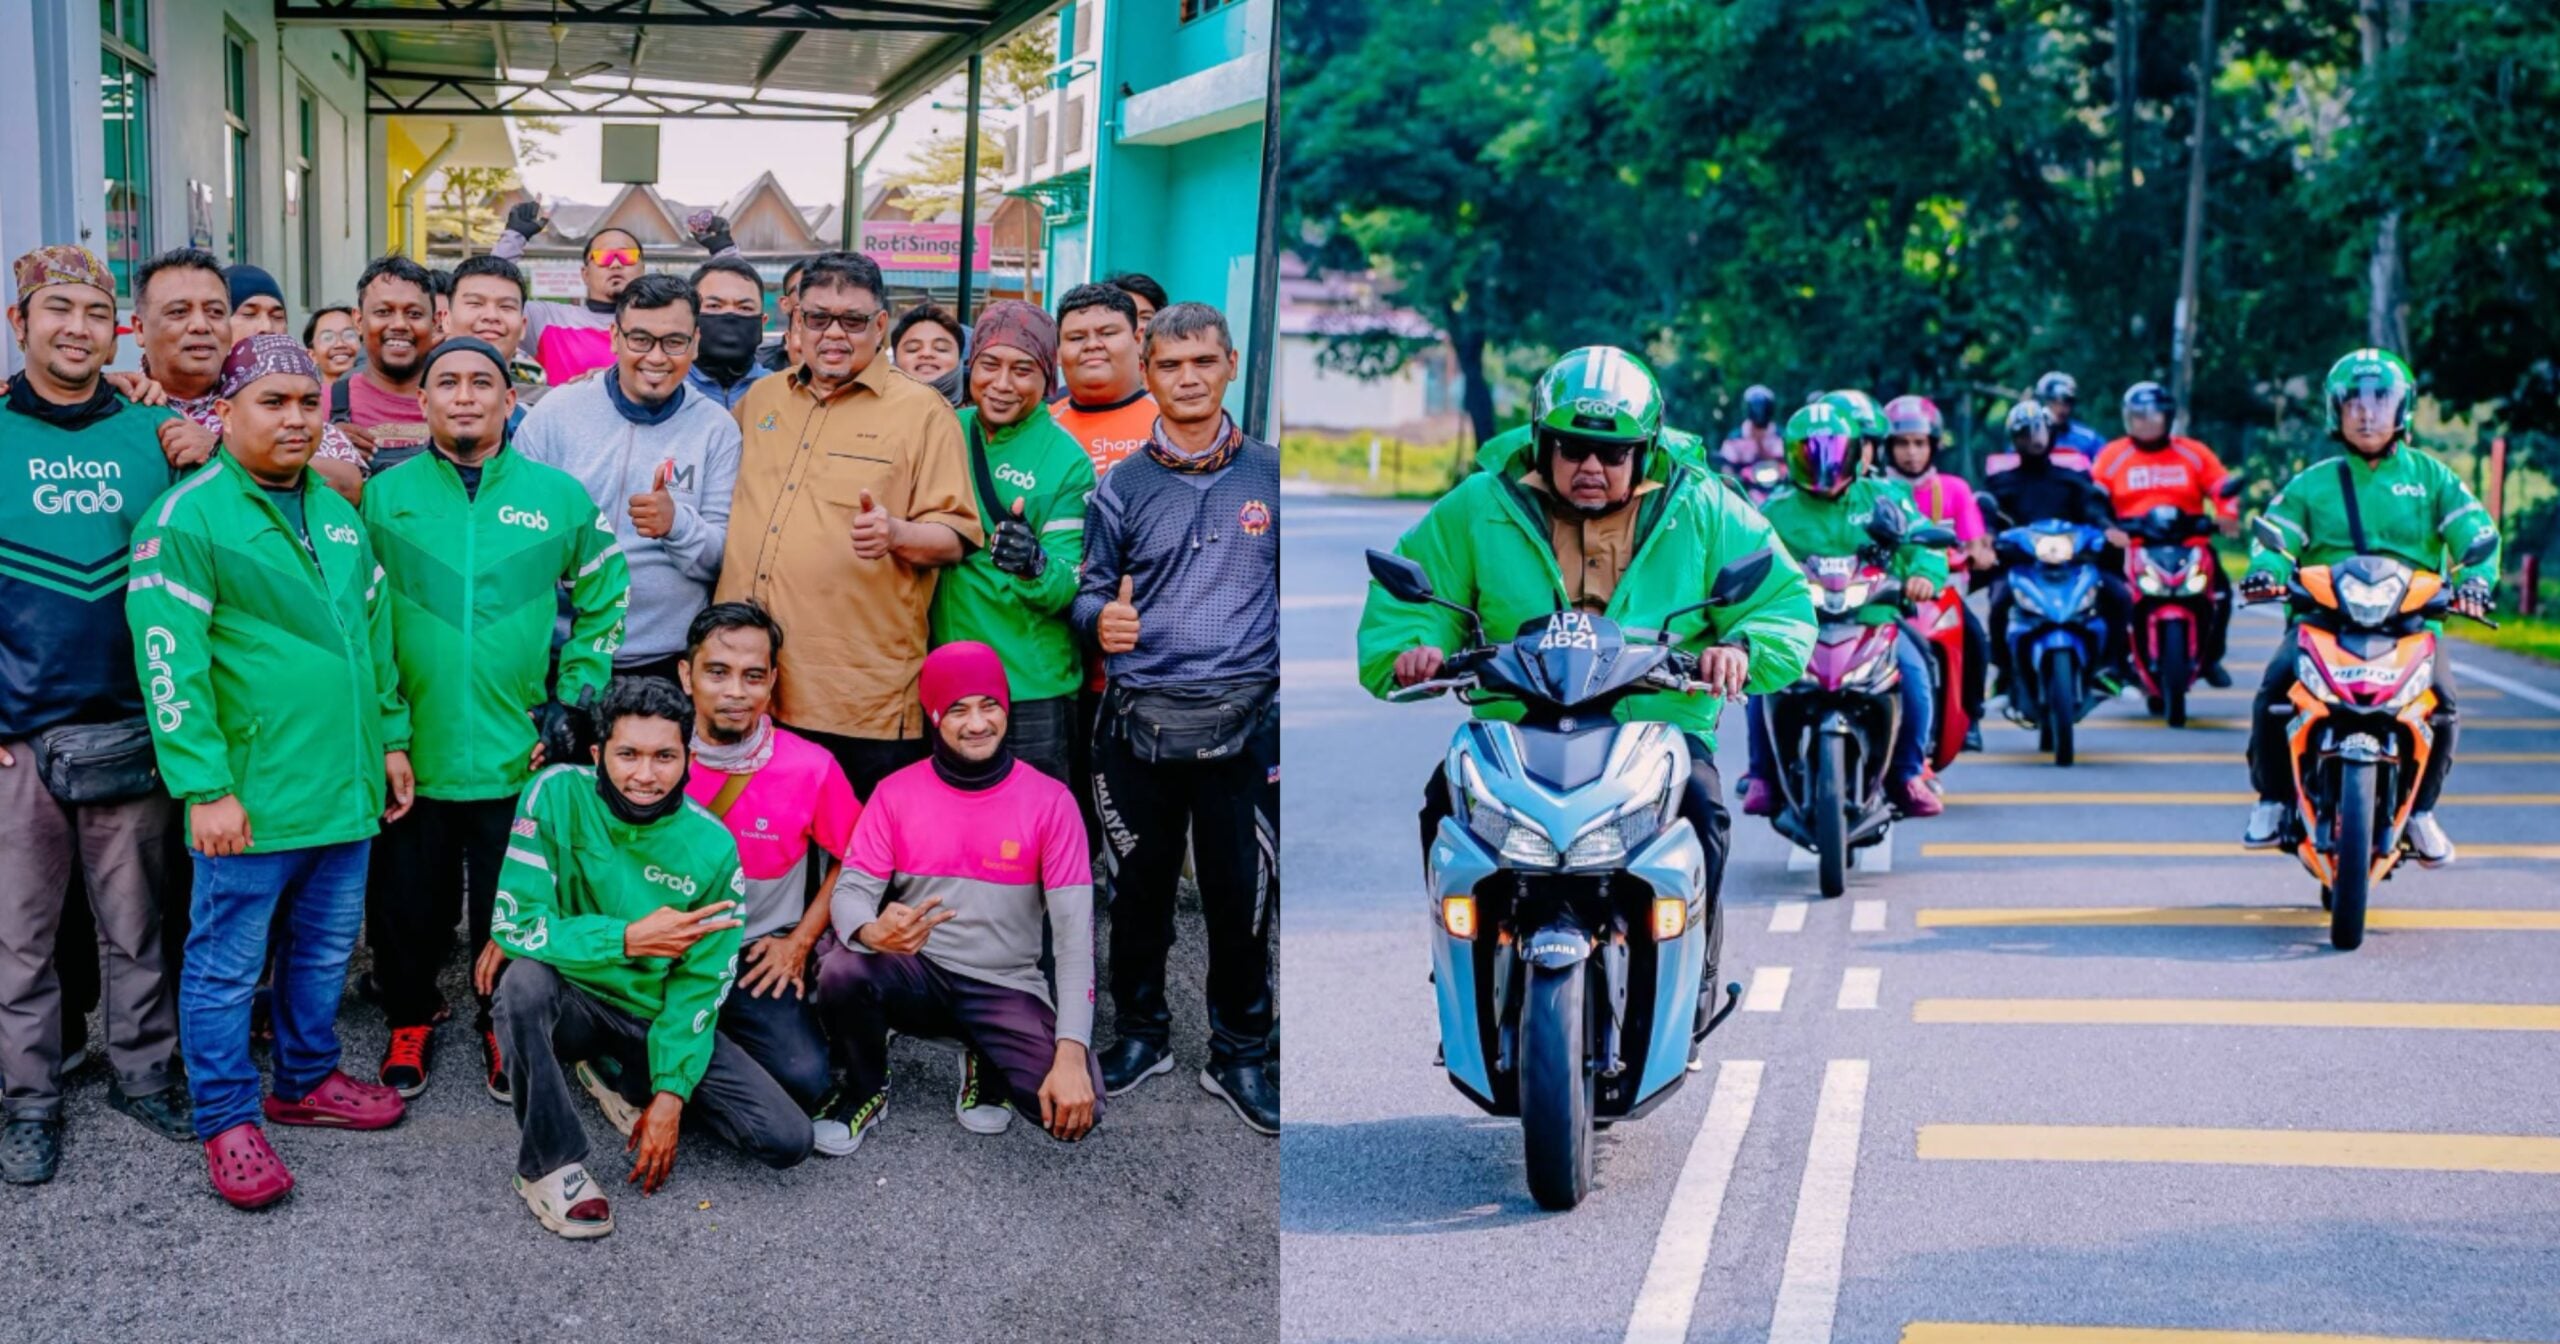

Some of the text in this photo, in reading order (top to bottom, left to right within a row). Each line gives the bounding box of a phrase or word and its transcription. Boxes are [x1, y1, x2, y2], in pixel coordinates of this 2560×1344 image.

[864, 234, 979, 256] RotiSingg
[29, 454, 121, 480] Rakan
[994, 463, 1036, 490] Grab
[33, 480, 123, 515] Grab
[498, 504, 549, 531] Grab
[324, 523, 359, 546] Grab
[1546, 612, 1593, 633] APA
[1538, 631, 1598, 650] 4621
[145, 625, 191, 733] Grab
[644, 864, 697, 897] Grab
[563, 1169, 586, 1188] NIKE
